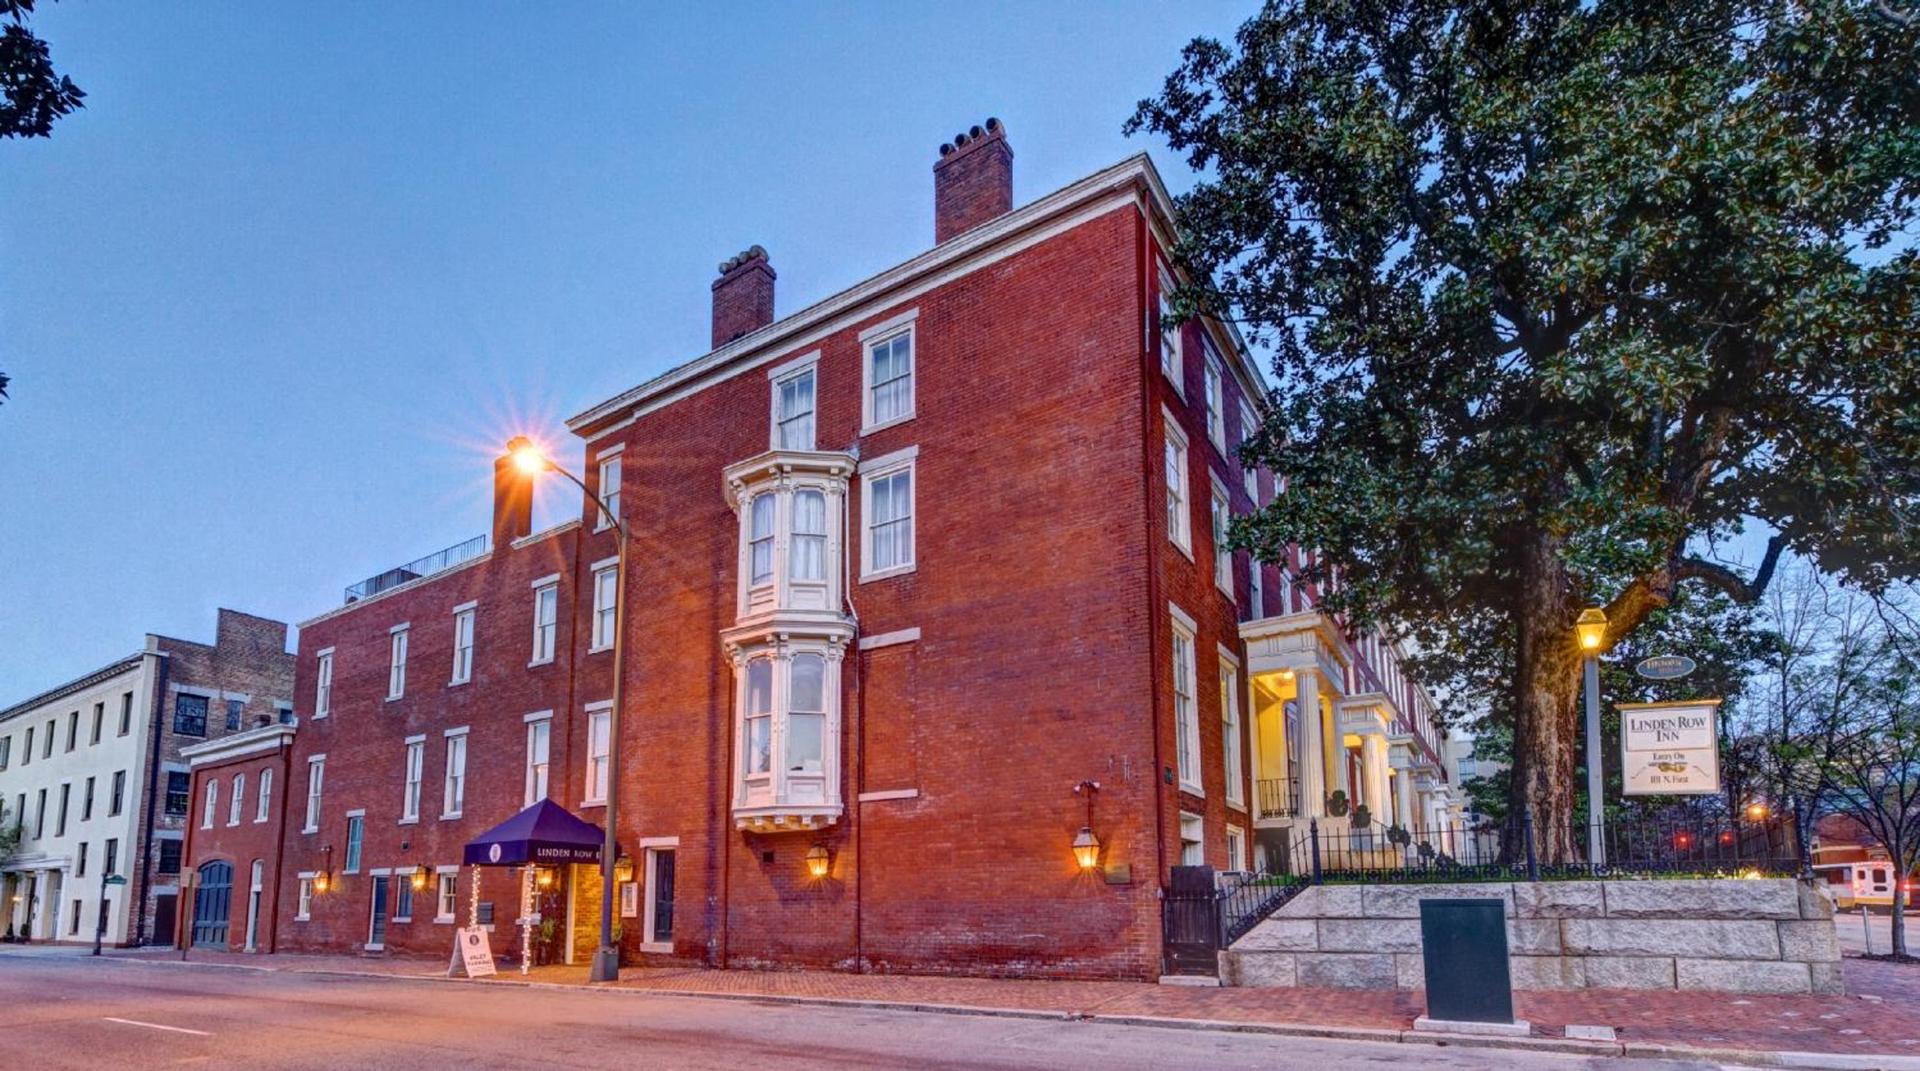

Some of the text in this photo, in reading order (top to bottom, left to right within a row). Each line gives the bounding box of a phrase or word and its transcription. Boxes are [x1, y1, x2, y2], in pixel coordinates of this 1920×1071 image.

[1631, 716, 1706, 731] LINDEN ROW
[1656, 729, 1680, 742] INN
[537, 847, 570, 858] LINDEN
[574, 849, 593, 859] ROW
